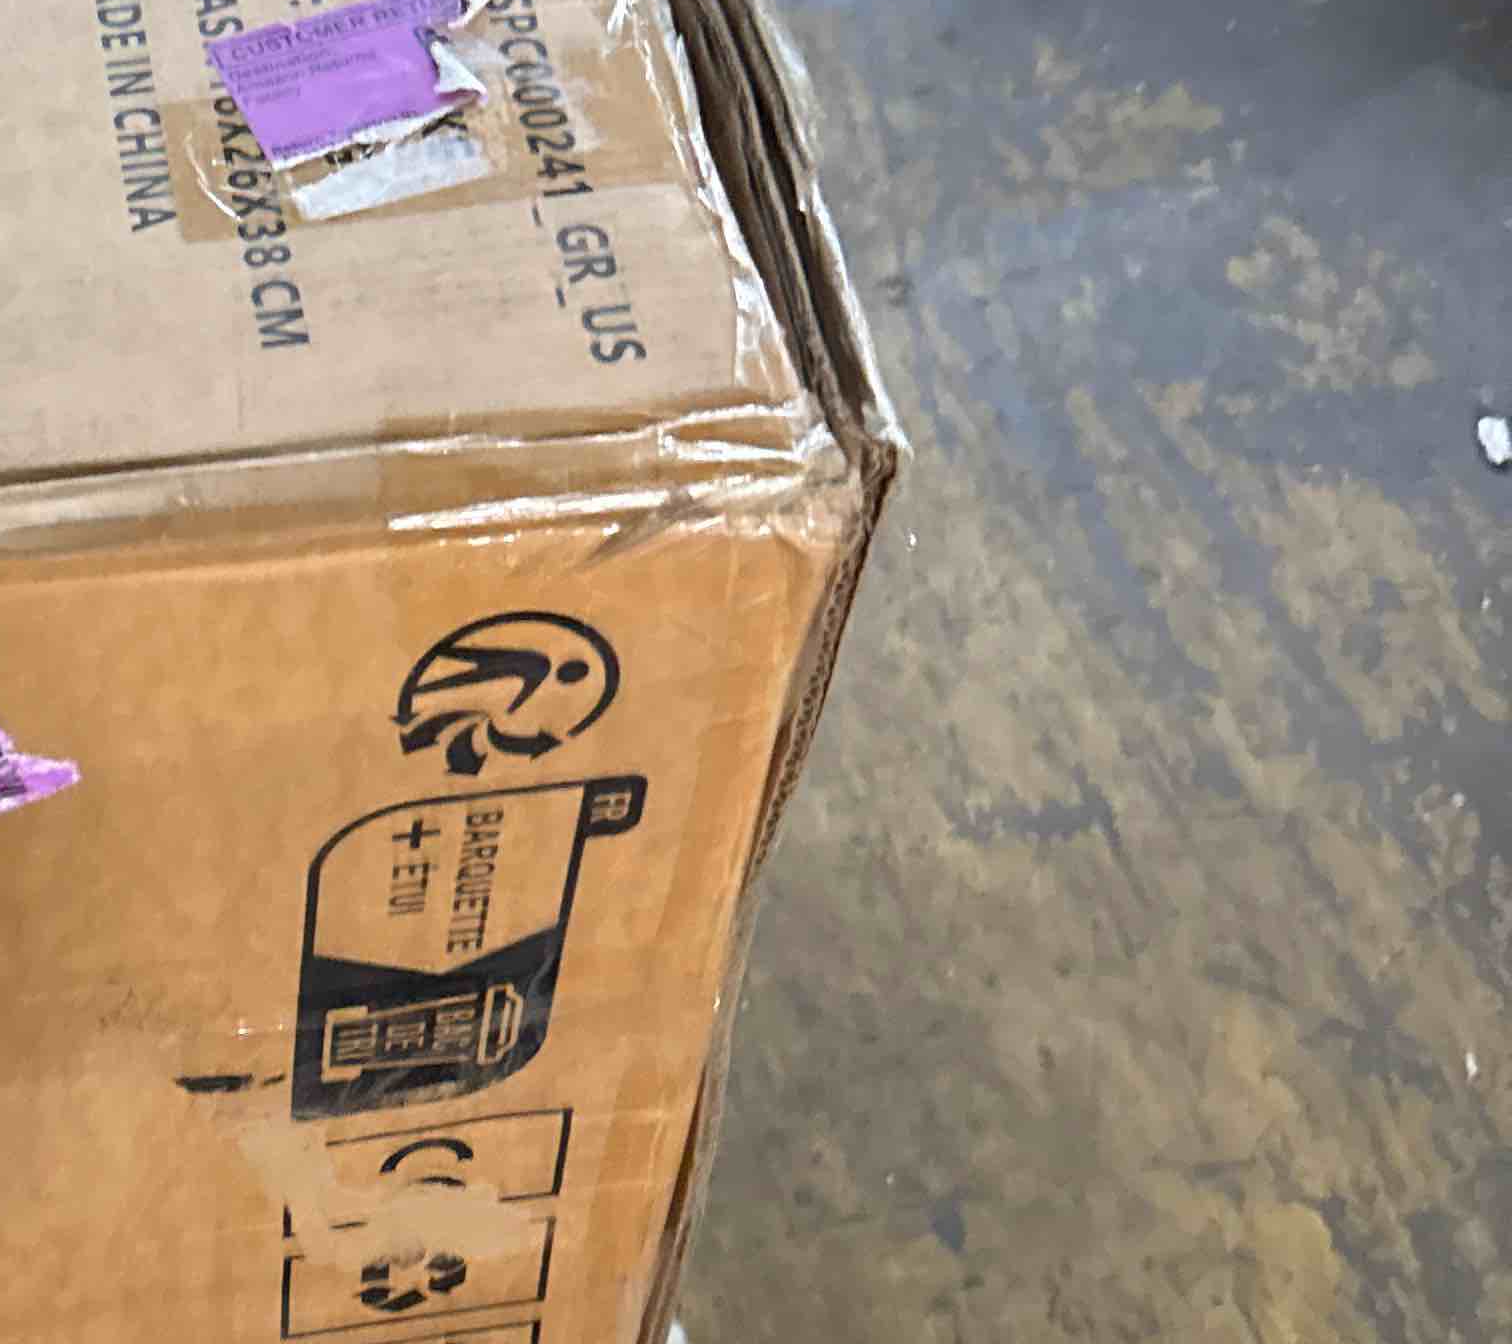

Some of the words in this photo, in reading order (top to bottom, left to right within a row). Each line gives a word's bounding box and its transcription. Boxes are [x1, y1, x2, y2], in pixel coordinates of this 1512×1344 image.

[105, 55, 156, 98] IN
[112, 106, 179, 234] CHINA
[251, 278, 311, 350] CM
[591, 792, 633, 824] FR
[446, 806, 504, 954] BARQUETTE
